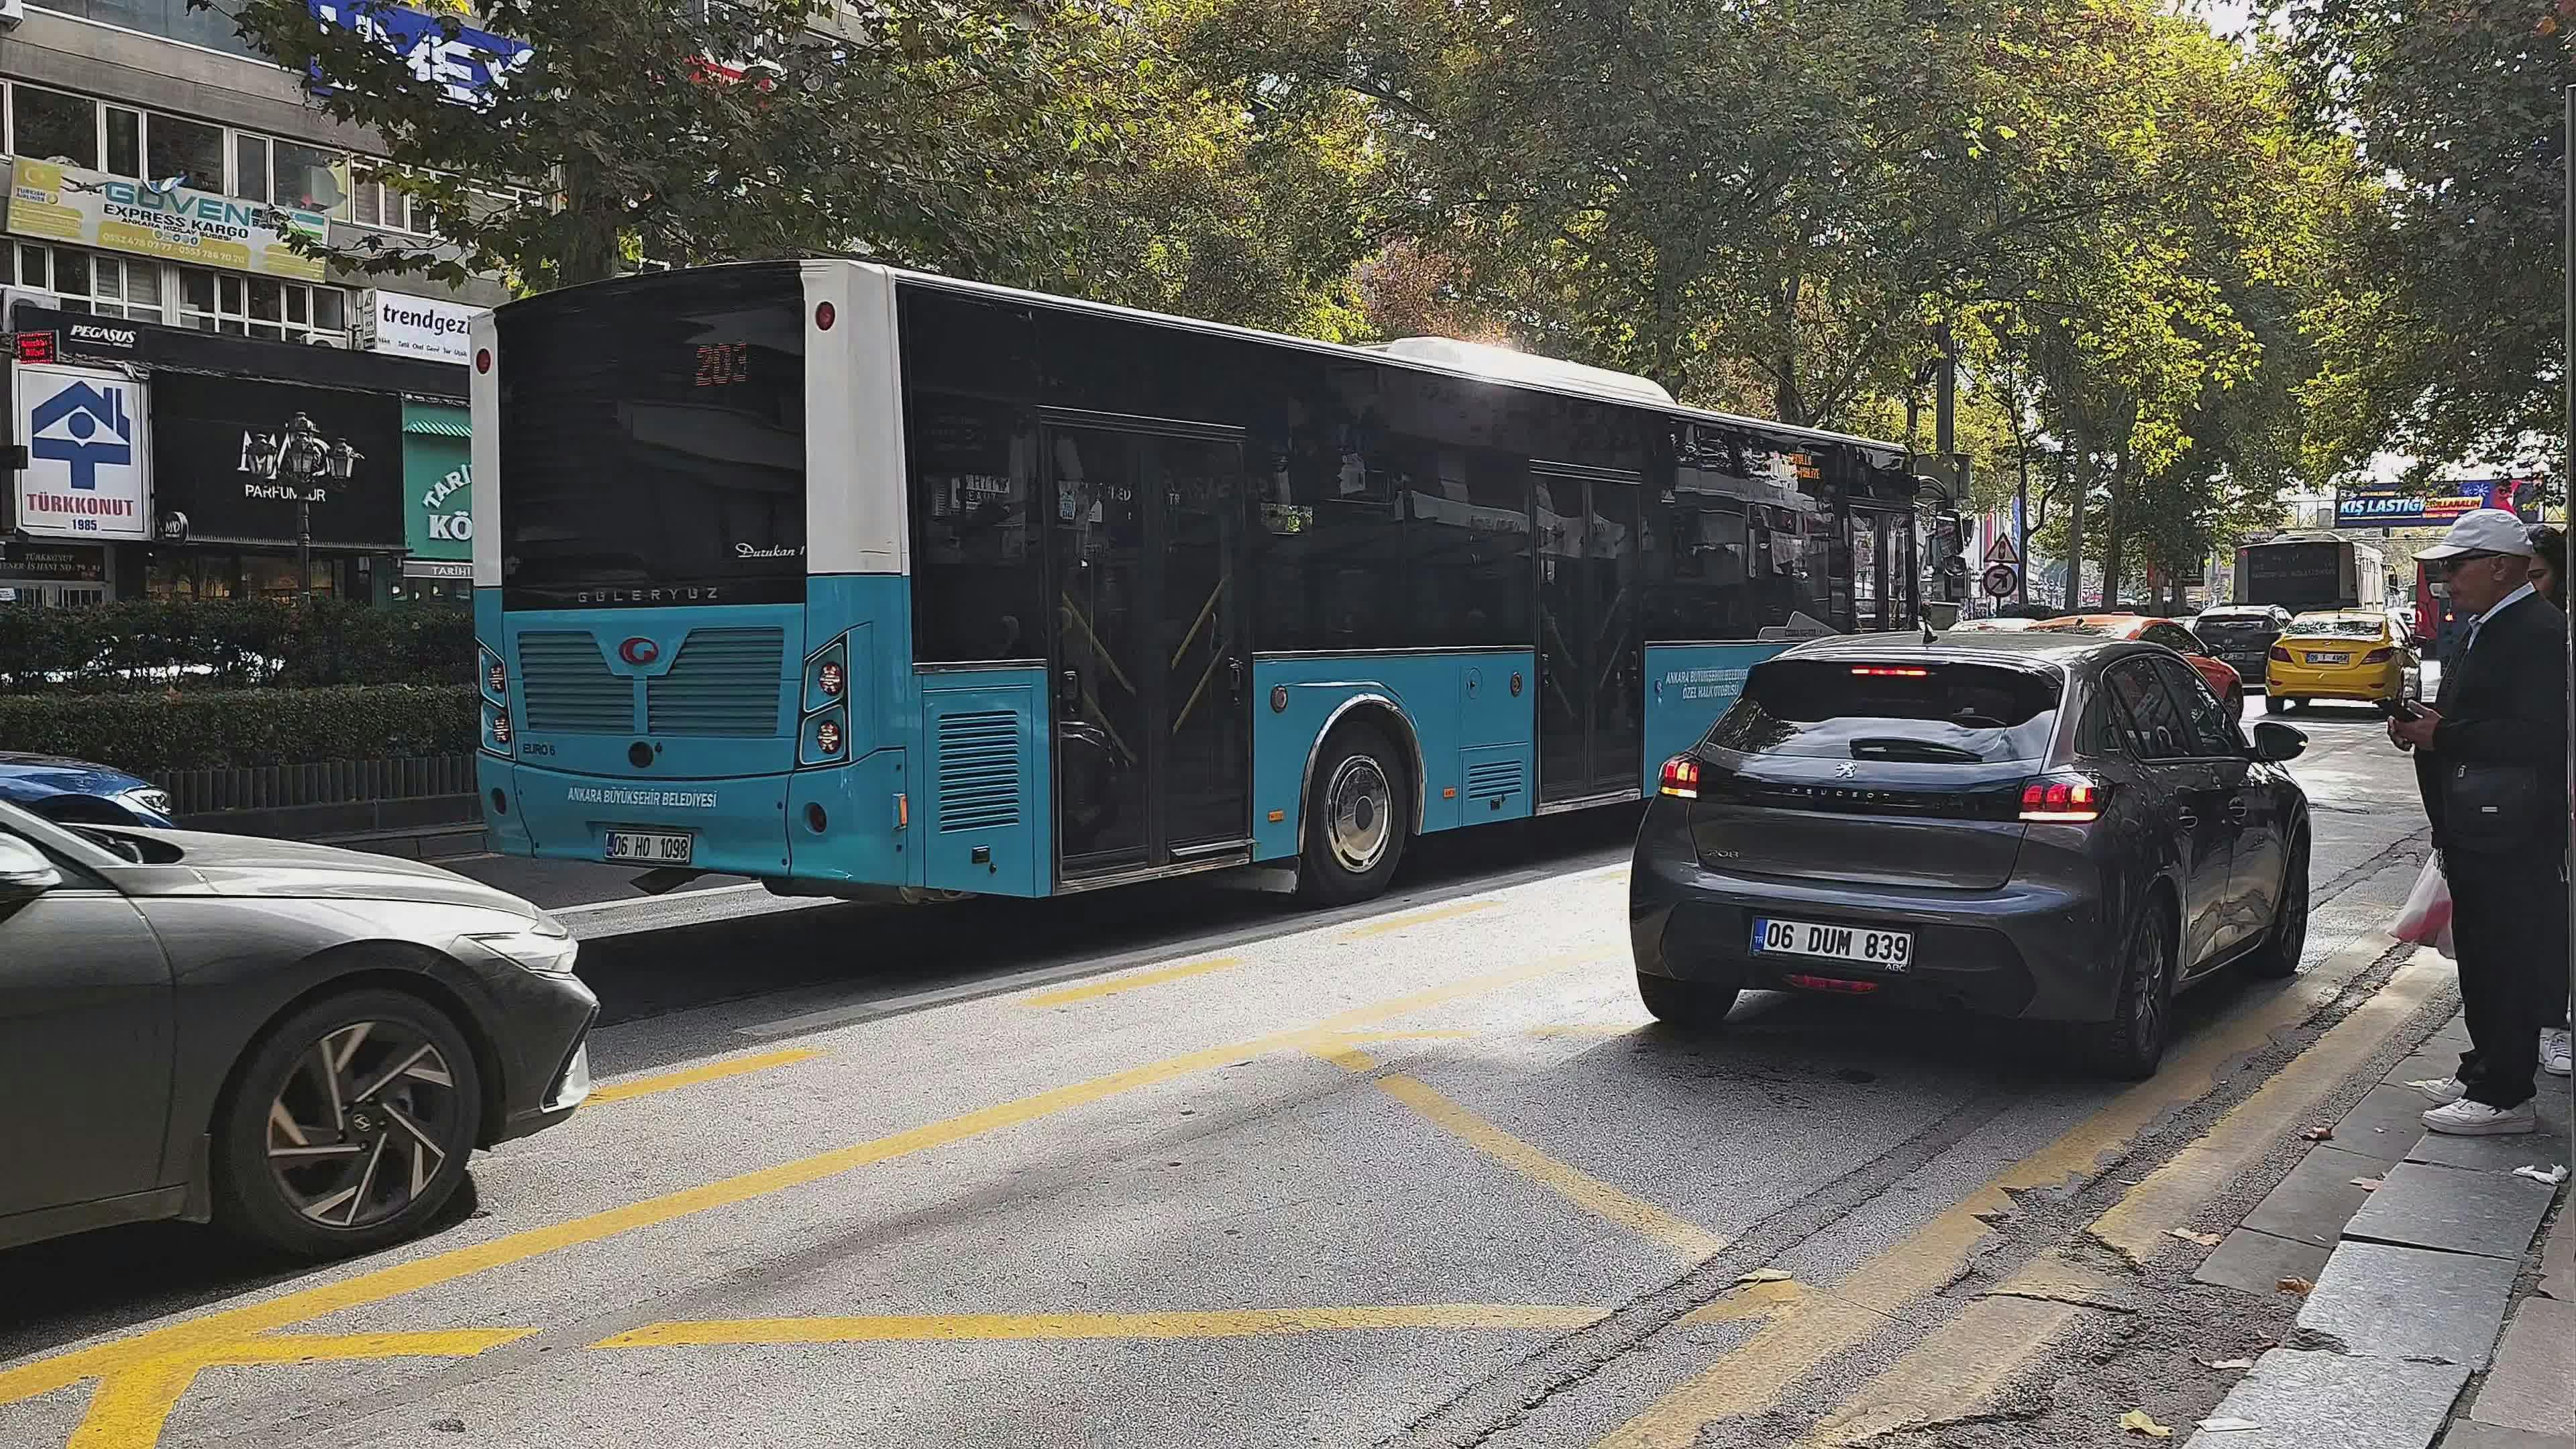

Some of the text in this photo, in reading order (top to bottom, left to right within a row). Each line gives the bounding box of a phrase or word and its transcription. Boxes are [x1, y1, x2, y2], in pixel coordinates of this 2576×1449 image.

[103, 203, 186, 227] EXPRESS
[191, 219, 249, 239] KARGO
[121, 217, 161, 229] ANKARA
[70, 324, 137, 343] PEGASUS
[26, 491, 134, 517] TÜRKKONUT
[2339, 499, 2367, 515] KIŞ
[71, 519, 98, 531] 1985
[1665, 672, 1689, 684] ANKARA
[1682, 684, 1697, 699] ÖZEL
[523, 743, 549, 755] EURO
[568, 787, 602, 803] ANKARA
[661, 790, 718, 808] BELEDİYESİ
[1792, 787, 1890, 799] PEUGEOT
[613, 837, 629, 855] 06
[659, 838, 688, 859] 1098
[1767, 922, 1795, 949] 06
[1807, 927, 1853, 957] DUM
[1864, 933, 1909, 962] 839
